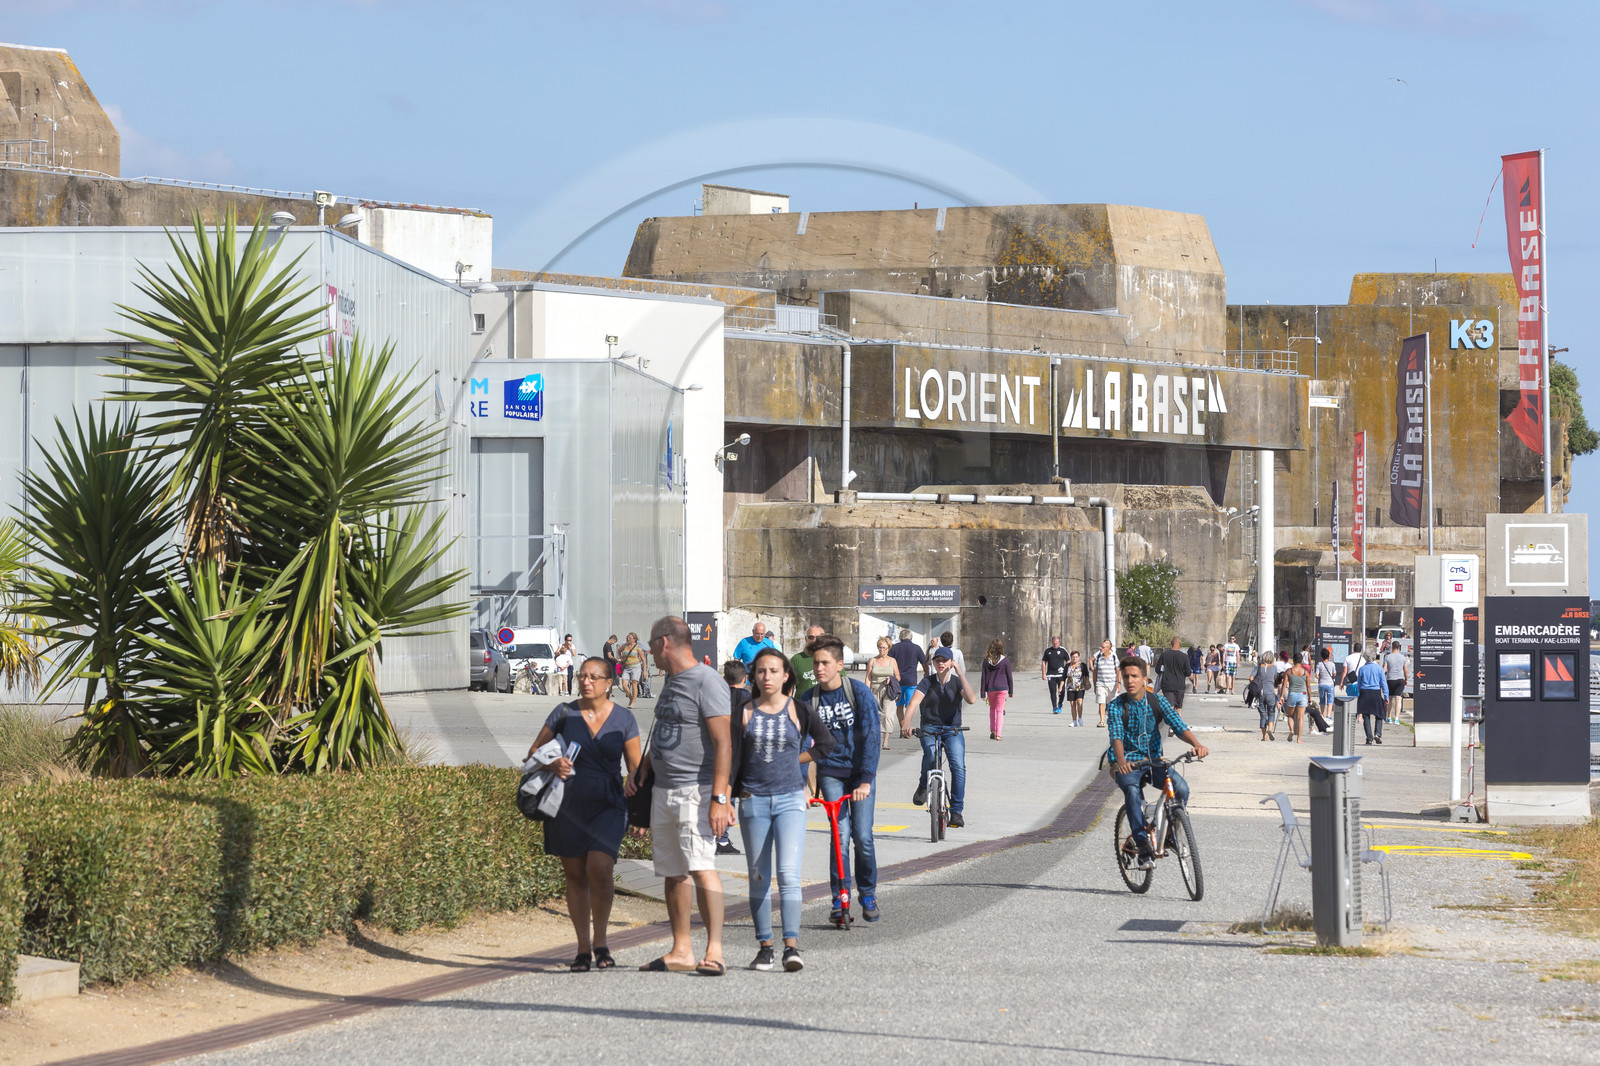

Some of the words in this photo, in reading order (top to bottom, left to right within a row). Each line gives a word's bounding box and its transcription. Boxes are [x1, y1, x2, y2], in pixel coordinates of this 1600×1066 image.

[1450, 319, 1494, 349] K3
[505, 411, 538, 419] POPULAIRE
[905, 367, 1041, 425] LORIENT
[1086, 369, 1121, 431] LA
[1132, 372, 1206, 436] BASE
[1405, 370, 1424, 444] BASE
[1390, 442, 1402, 486] LORIENT
[1401, 453, 1423, 488] LA
[887, 589, 910, 597] MUSÉE
[1495, 623, 1581, 636] EMBARCADÈRE
[825, 718, 854, 730] OKYO
